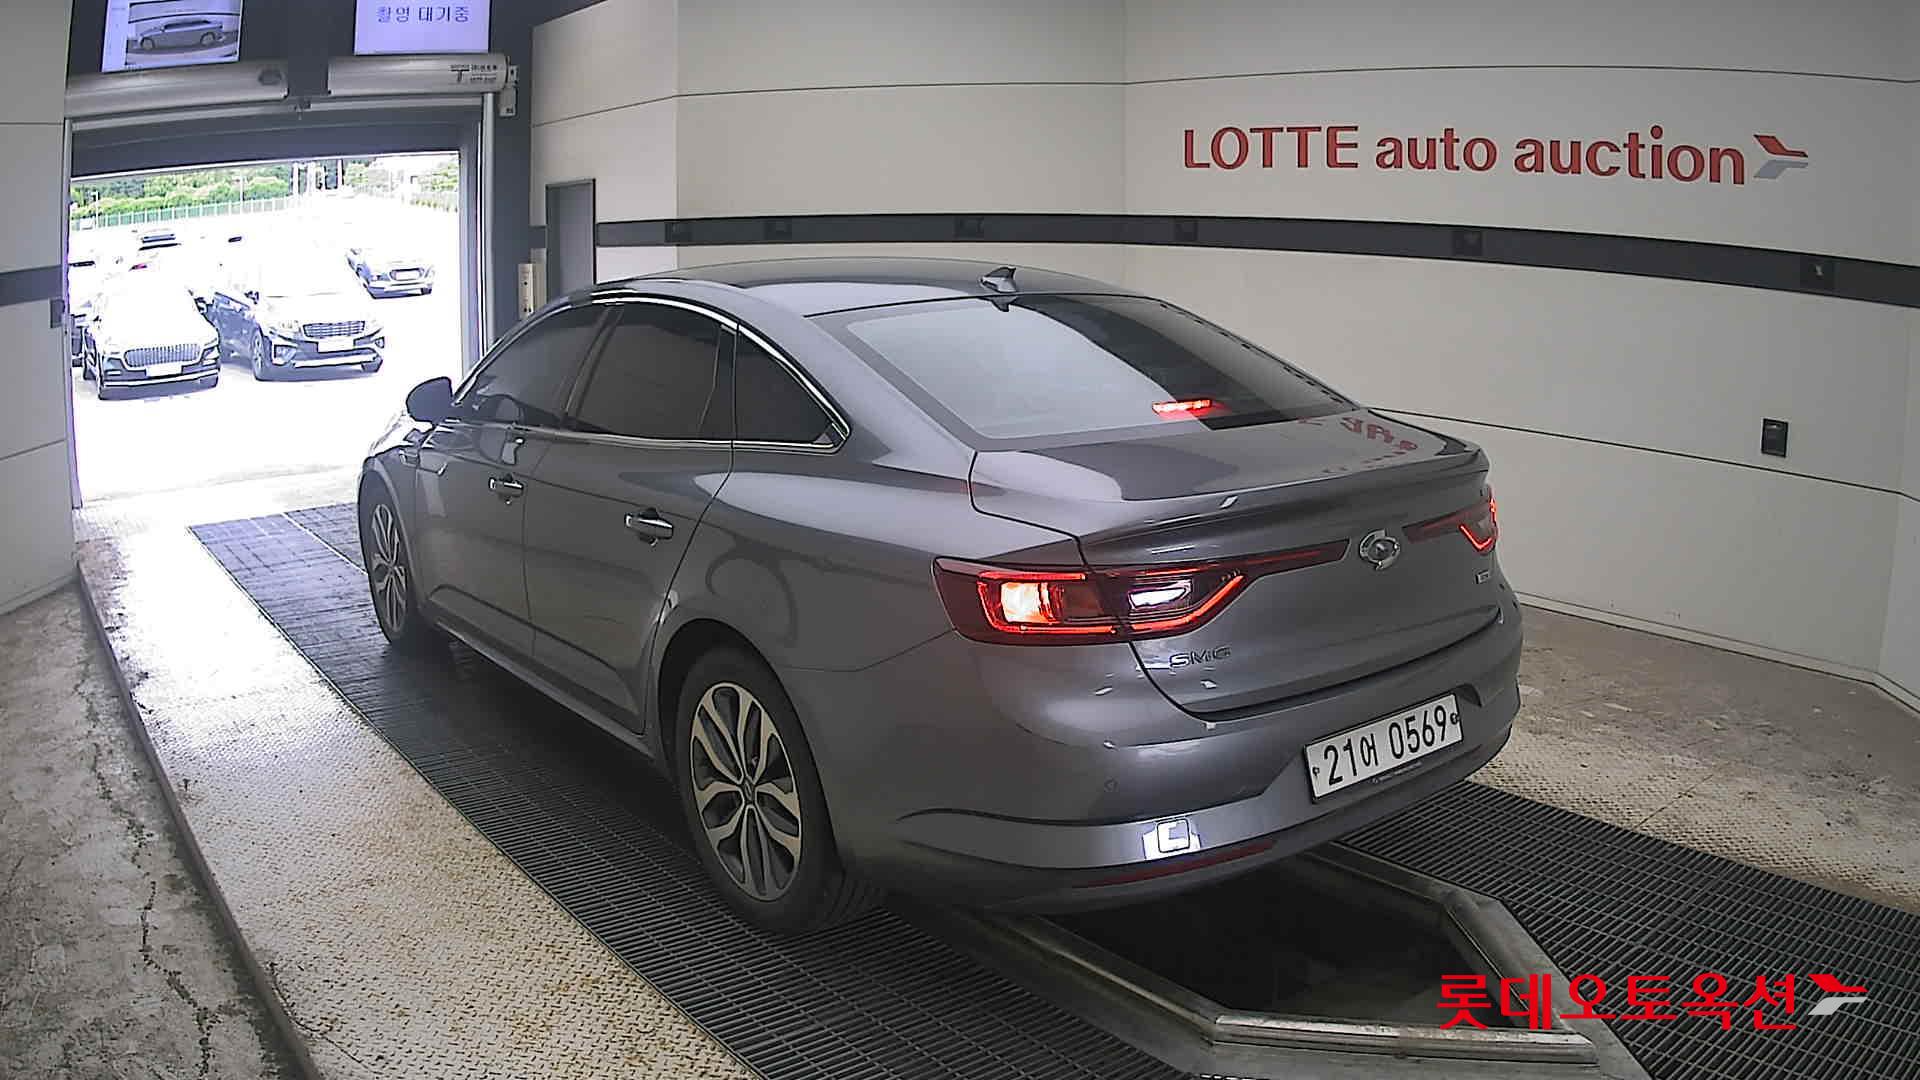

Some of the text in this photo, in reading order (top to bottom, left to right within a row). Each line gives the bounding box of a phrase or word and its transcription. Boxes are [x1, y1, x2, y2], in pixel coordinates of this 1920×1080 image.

[418, 6, 469, 23] 대기중
[1184, 125, 1745, 185] LOTTE auto auction
[1323, 732, 1379, 786] 21어
[1388, 705, 1447, 760] 0569
